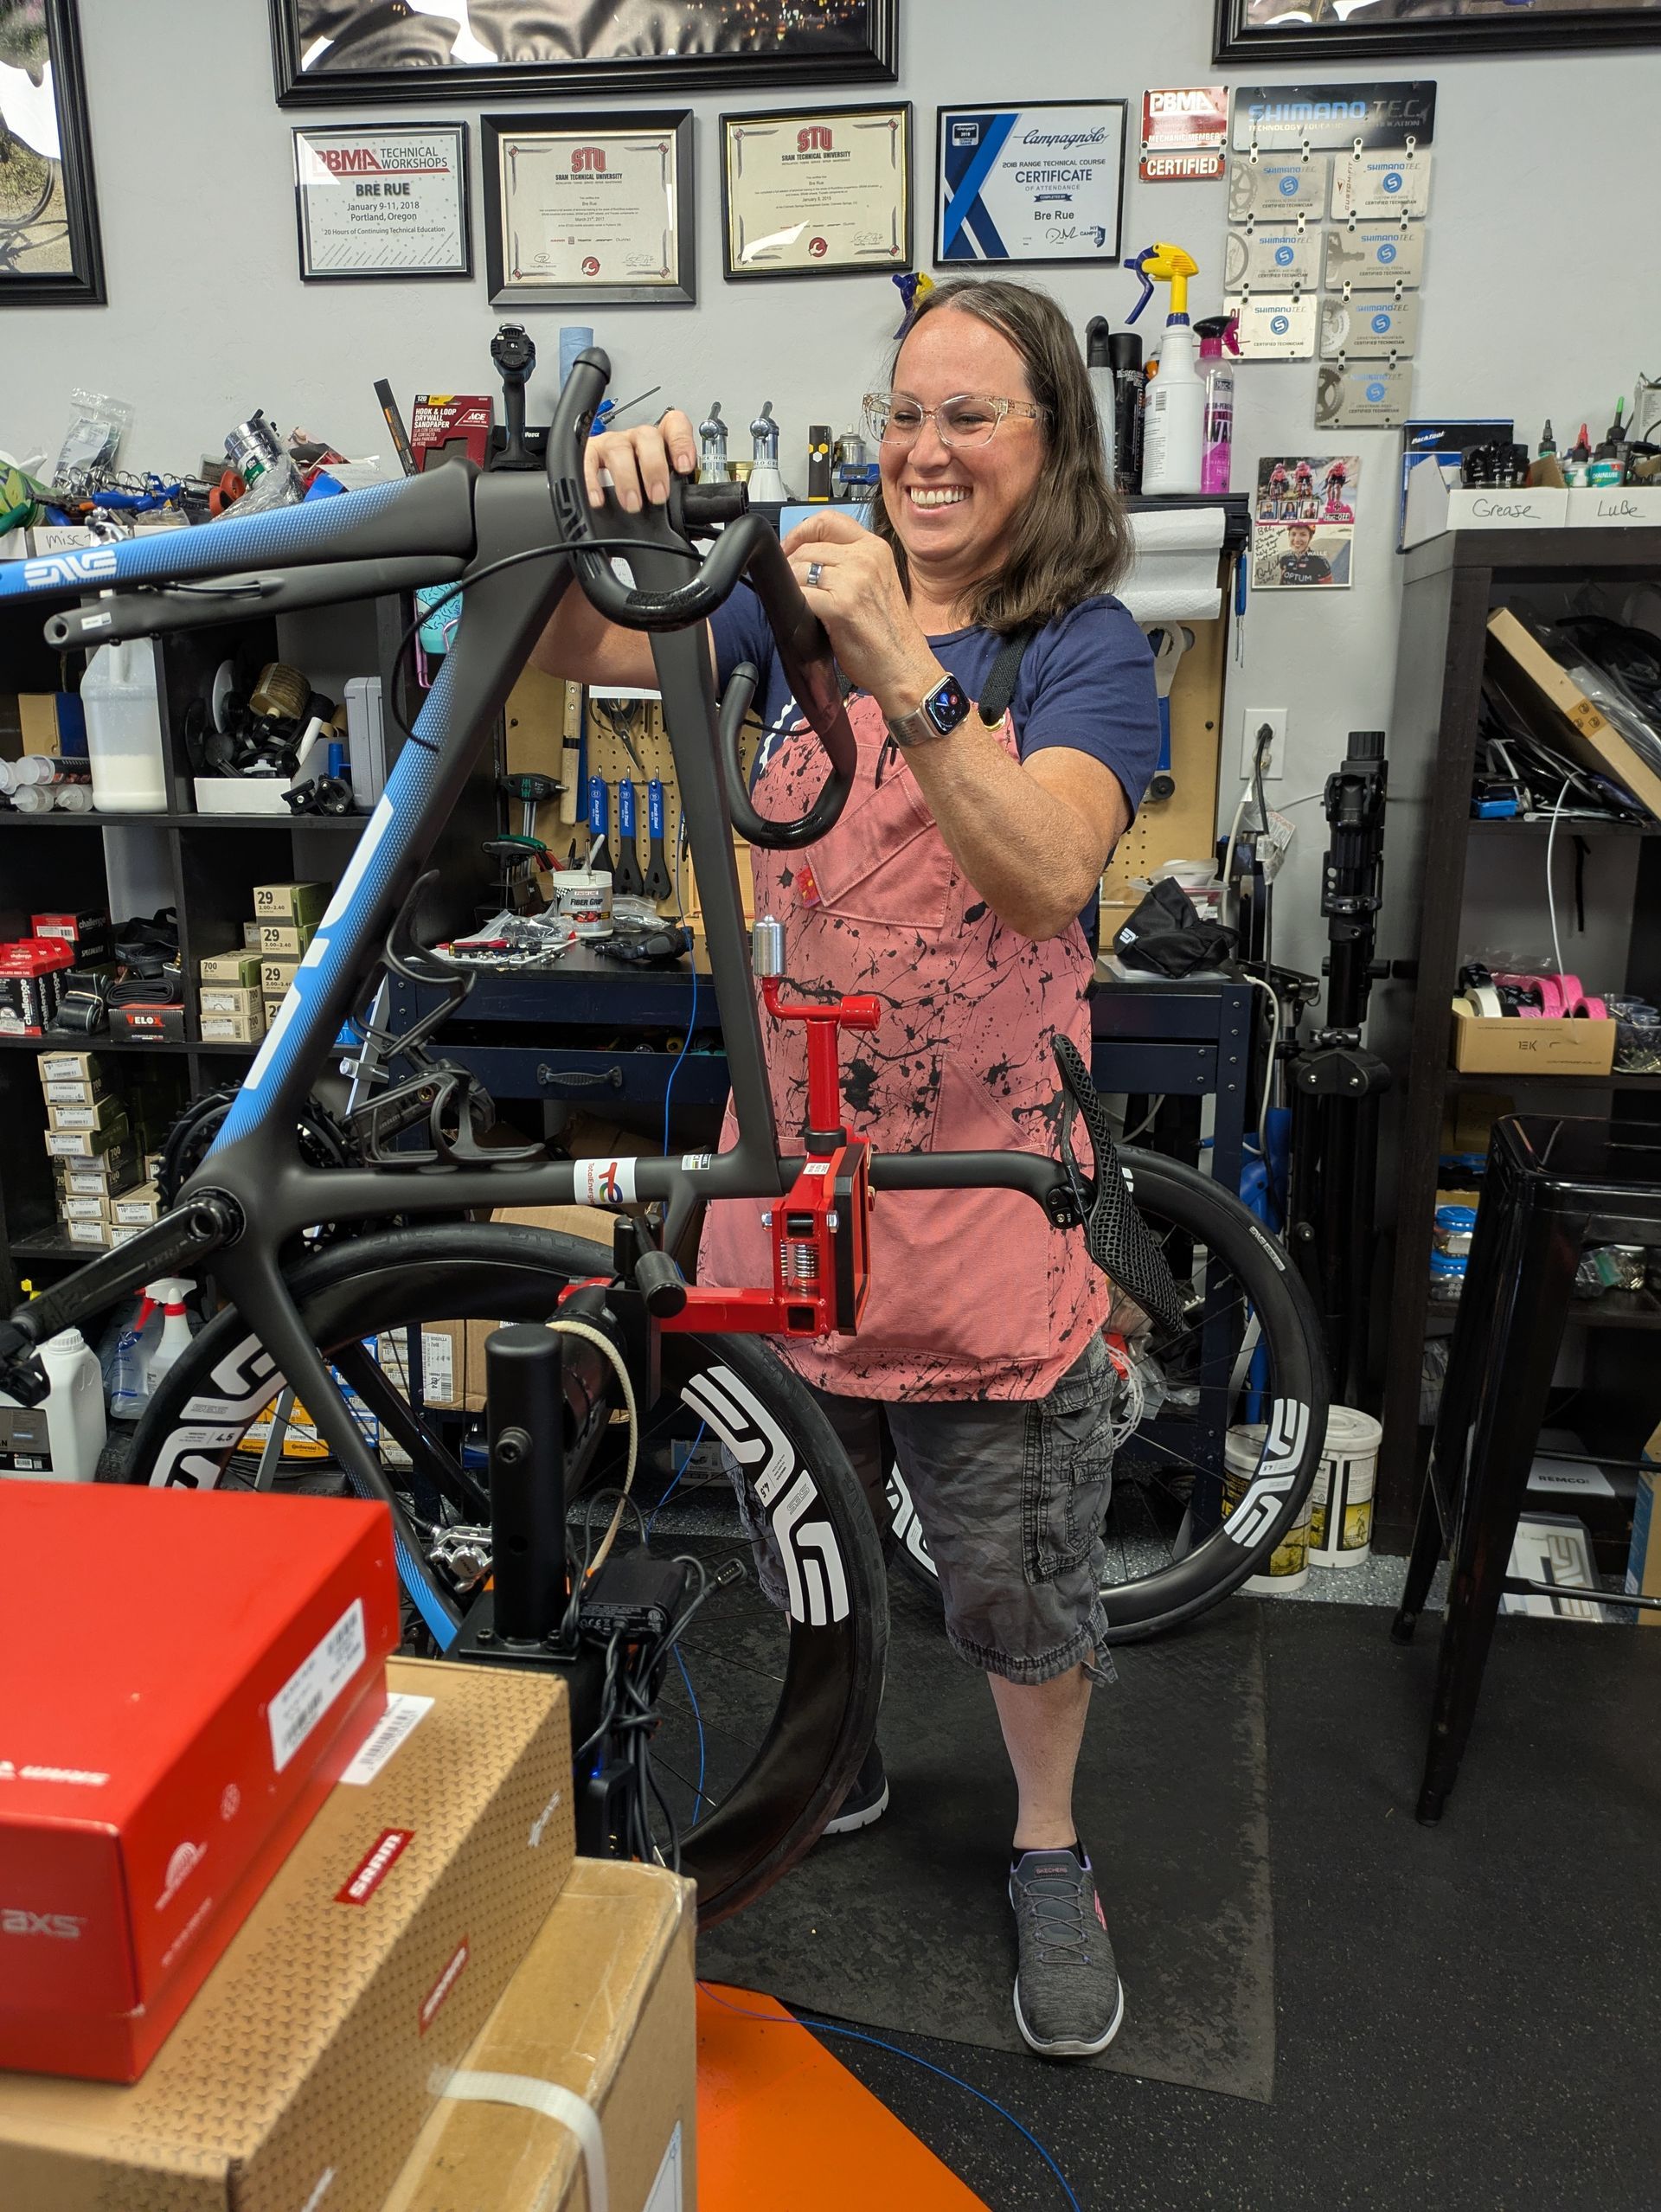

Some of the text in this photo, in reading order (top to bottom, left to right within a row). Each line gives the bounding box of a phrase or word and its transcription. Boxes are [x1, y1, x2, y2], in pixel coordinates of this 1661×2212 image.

[1150, 91, 1215, 112] PBMA
[1247, 101, 1367, 123] SHIMANO
[798, 126, 832, 152] STU
[1013, 127, 1109, 150] Campagnolo
[1189, 133, 1220, 142] MEMBER
[381, 147, 438, 157] TECHNICAL
[798, 152, 822, 161] TECHNICAL
[824, 151, 851, 159] UNIVERSITY
[382, 157, 447, 169] WORKSHOPS
[571, 147, 606, 173] STU
[1147, 157, 1218, 176] CERTIFIED
[1016, 170, 1092, 183] CERTIFICATE
[356, 183, 410, 196] BRE RUE
[347, 202, 377, 212] January
[379, 202, 399, 211] 9-11,
[351, 213, 417, 221] Portland, Oregon
[1035, 211, 1074, 220] Bre Rue
[357, 227, 389, 236] Continuing
[468, 412, 486, 420] ACE
[1472, 498, 1542, 519] Grease
[24, 548, 117, 587] ENVE
[1284, 572, 1311, 581] OPTUM
[258, 891, 273, 905] 29
[79, 917, 106, 929] challenge
[264, 929, 279, 941] 29
[265, 967, 280, 981] 29
[21, 979, 32, 1026] challenge
[38, 978, 49, 1031] challenge
[126, 1015, 164, 1027] VELOX
[110, 1146, 121, 1157] 700
[109, 1170, 119, 1183] 700
[215, 1433, 235, 1441] 4.5
[760, 1481, 770, 1498] 4.5
[348, 1832, 403, 1898] SRAM
